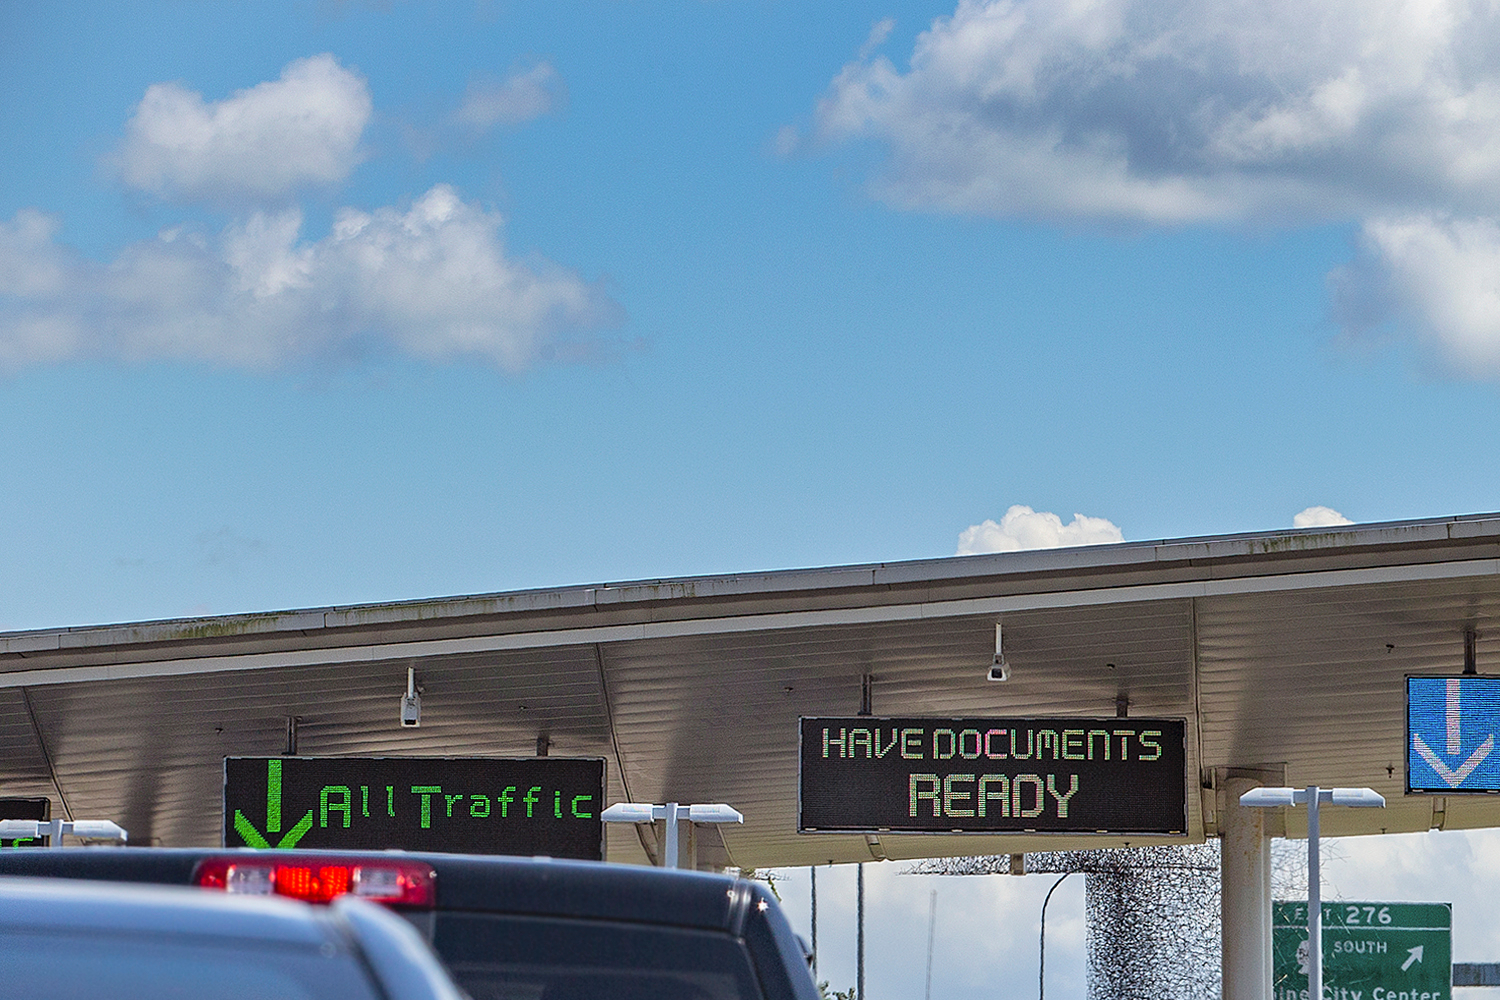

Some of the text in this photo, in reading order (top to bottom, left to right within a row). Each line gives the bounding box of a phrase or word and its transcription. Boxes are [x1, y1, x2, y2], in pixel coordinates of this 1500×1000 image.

[822, 728, 1162, 761] HAVE DOCUMENTS
[320, 785, 593, 829] All Traffic
[909, 773, 1080, 819] READY
[1295, 906, 1392, 924] ET 276
[1334, 941, 1388, 954] SOUTH
